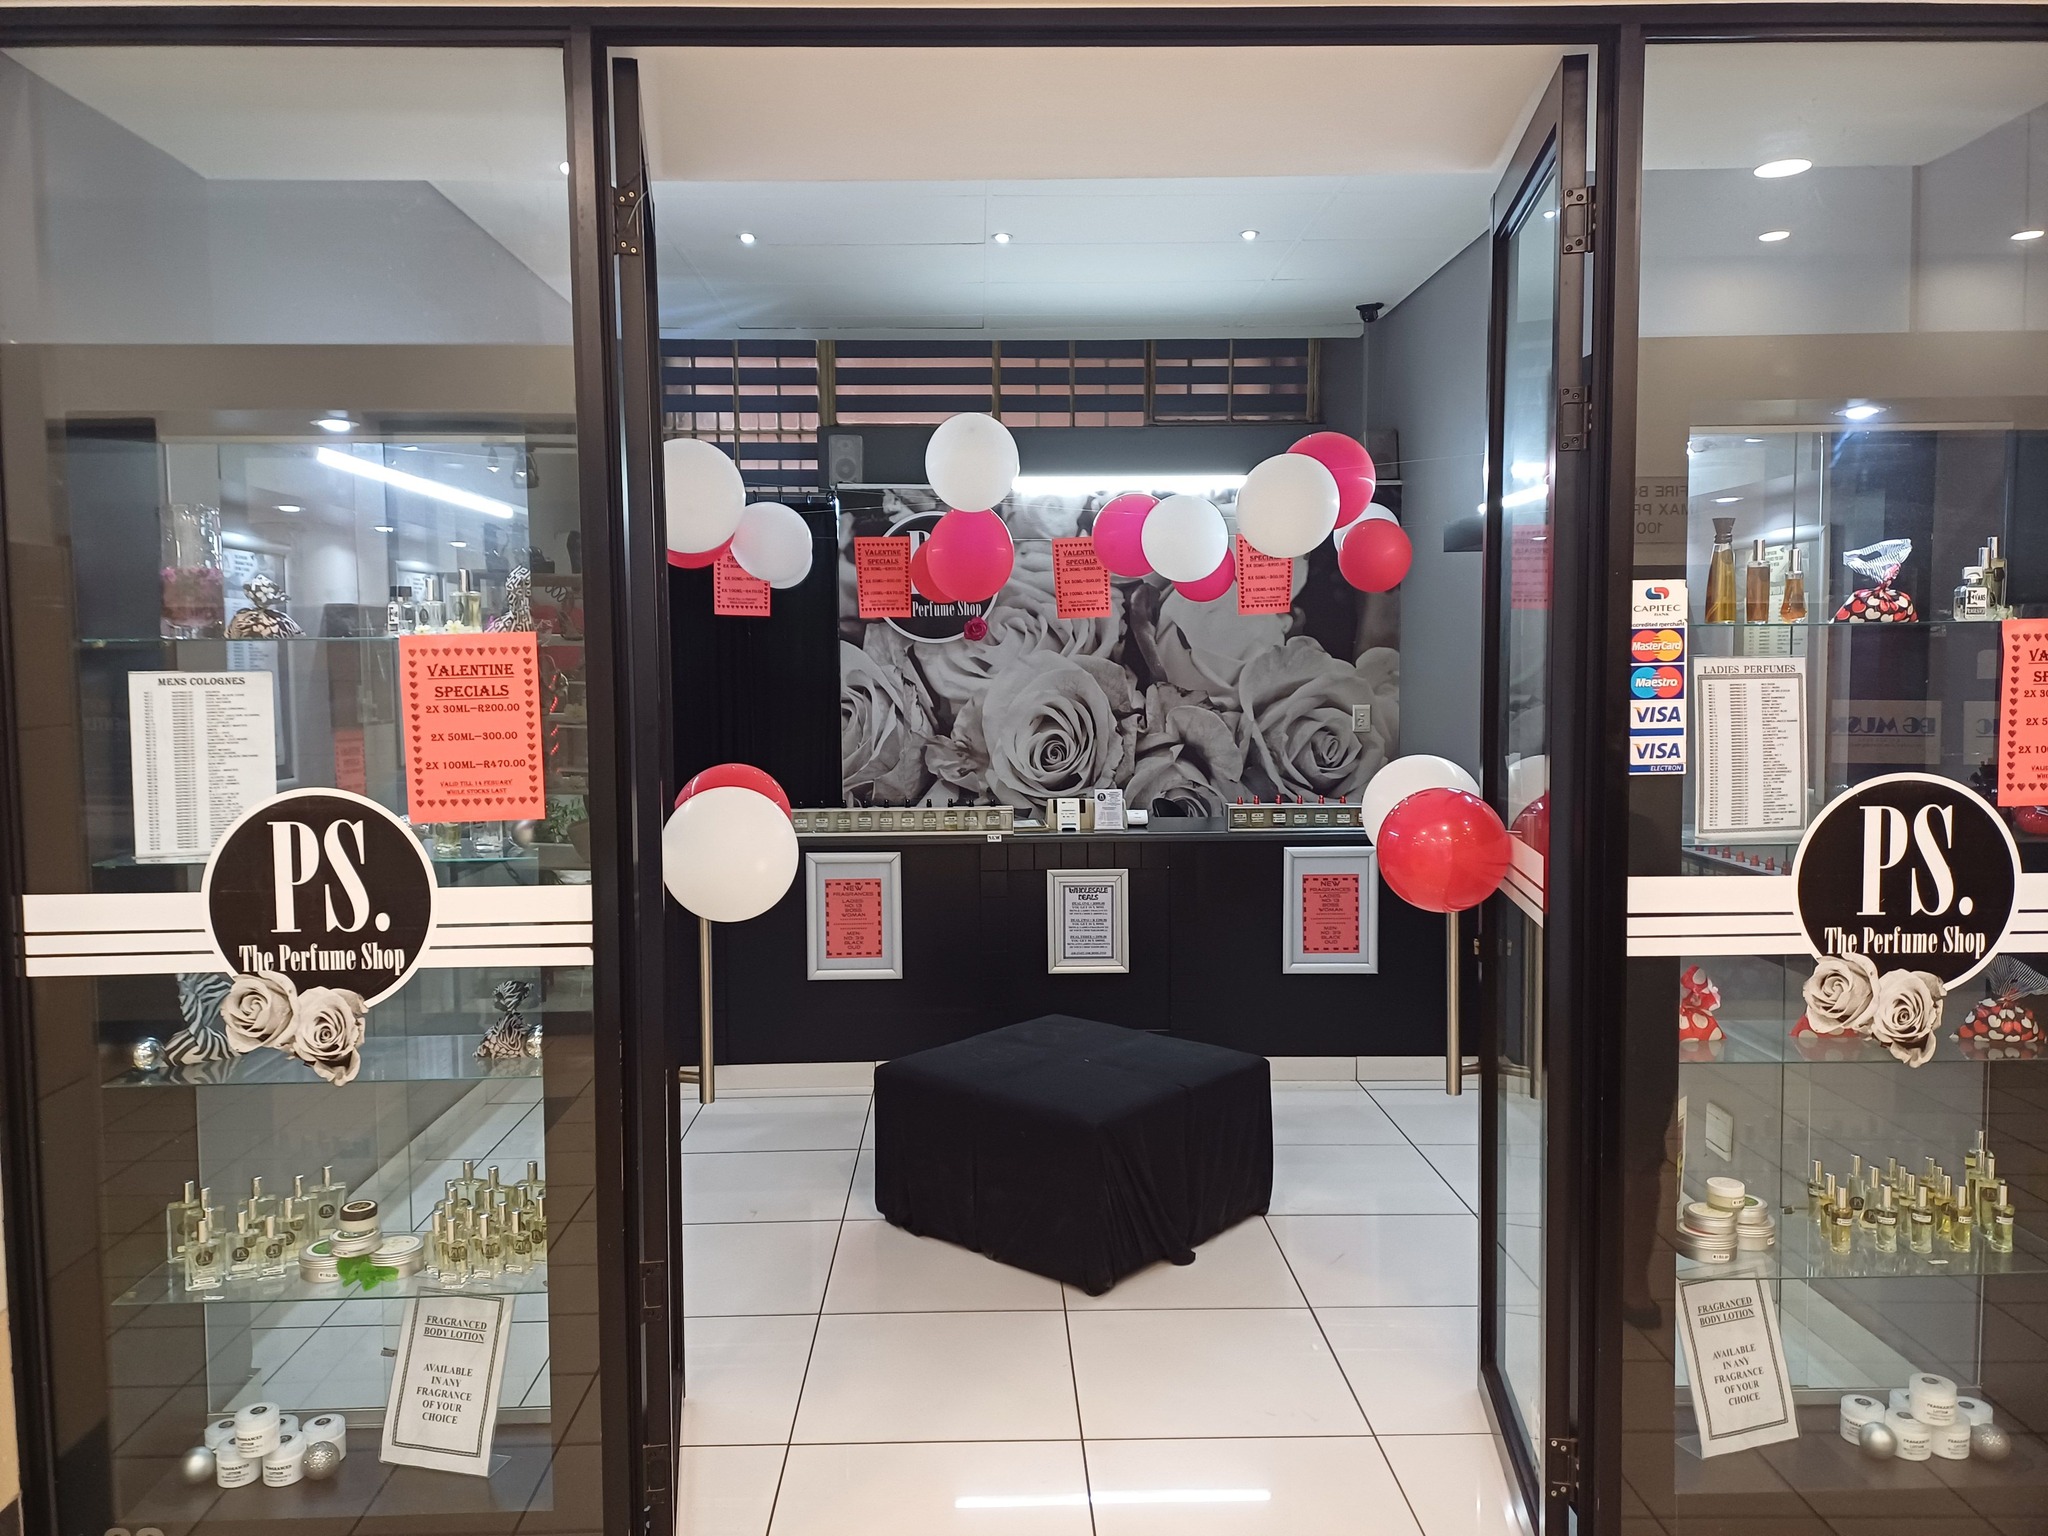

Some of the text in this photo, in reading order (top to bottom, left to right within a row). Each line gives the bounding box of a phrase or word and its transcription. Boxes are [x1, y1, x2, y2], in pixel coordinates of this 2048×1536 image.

[912, 601, 981, 617] Perfume Shop
[1632, 641, 1682, 651] MasterCard
[427, 664, 514, 677] VALENTINE
[1703, 665, 1796, 674] LADIES PERFUMES
[158, 677, 245, 686] MENS COLOGNES
[1635, 678, 1678, 687] Maestro
[435, 685, 509, 698] SPECIALS
[426, 705, 439, 713] 2X
[1633, 706, 1681, 722] VISA
[2026, 717, 2039, 725] 2X
[431, 733, 444, 741] 2X
[1633, 743, 1681, 759] VISA
[2018, 745, 2031, 753] 2X
[1856, 804, 1973, 916] PS.
[267, 819, 390, 932] PS.
[1824, 926, 1986, 959] The Perfume Shop
[239, 942, 405, 976] The Perfume Shop
[1697, 1296, 1753, 1314] FRAGRANCED
[426, 1315, 488, 1330] FRAGRANCED
[1700, 1308, 1755, 1326] BODY LOTION
[424, 1327, 485, 1342] BODY LOTION
[1712, 1344, 1757, 1361] AVAILABLE
[423, 1363, 473, 1377] AVAILABLE
[1723, 1357, 1750, 1370] IN ANY
[431, 1376, 462, 1388] IN ANY
[1714, 1367, 1764, 1384] FRAGRANCE
[416, 1386, 472, 1401] FRAGRANCE
[1724, 1380, 1760, 1395] OF YOUR
[1728, 1392, 1760, 1406] CHOICE
[422, 1400, 462, 1413] OF YOUR
[422, 1412, 458, 1424] CHOICE
